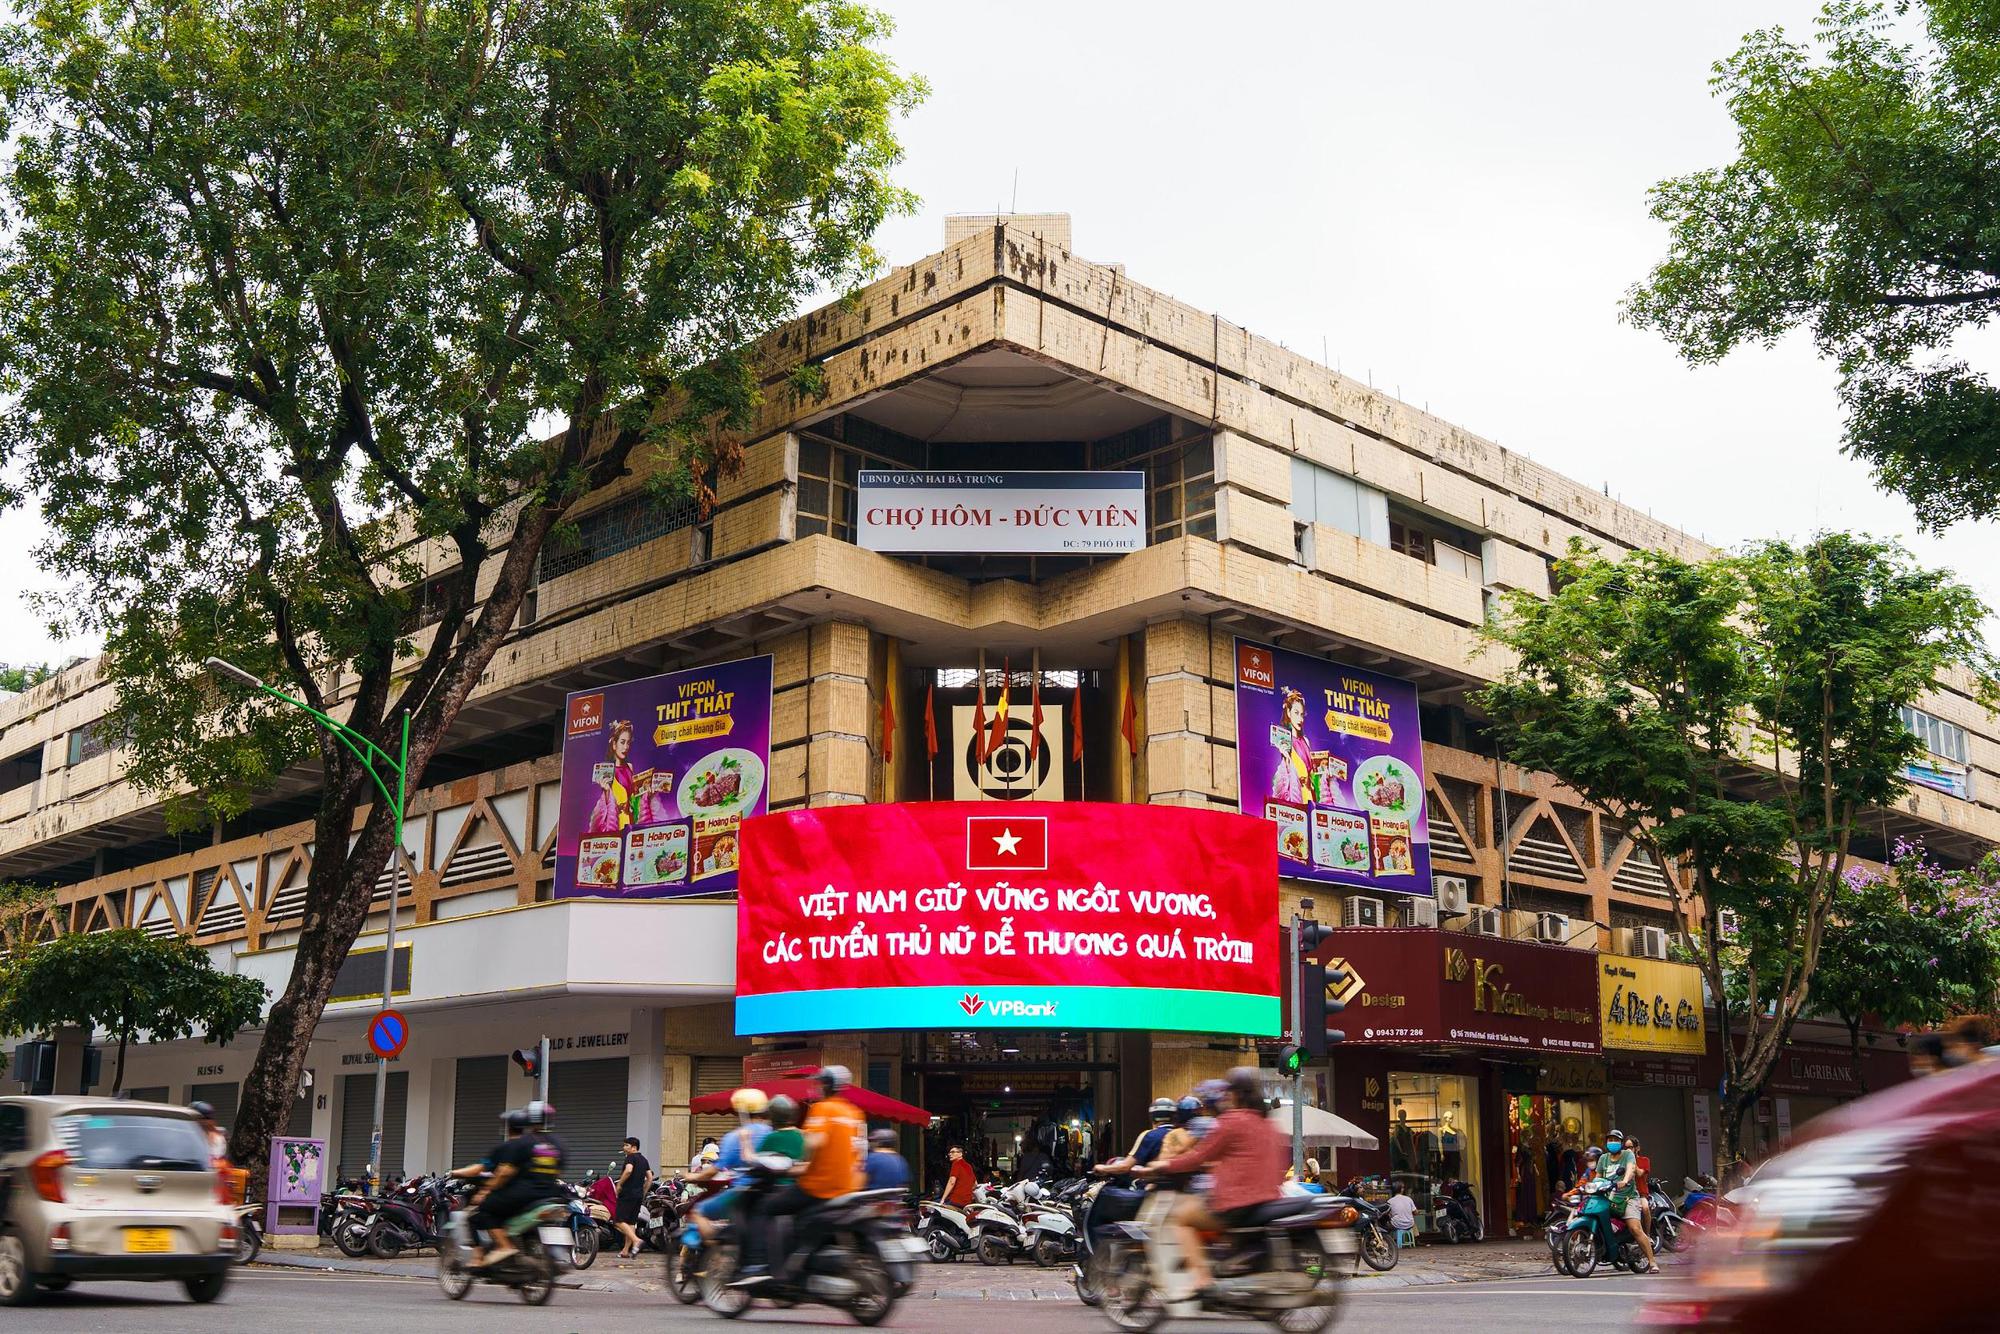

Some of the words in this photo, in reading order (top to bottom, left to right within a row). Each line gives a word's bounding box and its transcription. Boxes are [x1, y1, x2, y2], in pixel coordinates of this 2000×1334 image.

[861, 475, 890, 484] UBND
[892, 474, 923, 485] QUẬN
[926, 475, 945, 484] HAI
[948, 474, 963, 484] BÀ
[965, 474, 1003, 484] TRƯNG
[866, 507, 924, 531] CHỢ
[931, 504, 992, 527] HÔM
[1013, 504, 1069, 527] ĐỨC
[1076, 505, 1138, 527] VIÊN
[1082, 540, 1091, 548] 79
[1243, 667, 1270, 683] VIFON
[678, 679, 715, 698] VIFON
[1342, 677, 1374, 697] VIFON
[656, 700, 691, 722] THỊT
[694, 690, 734, 714] THẬT
[1324, 689, 1355, 712] THỊT
[1357, 698, 1391, 721] THẬT
[573, 715, 599, 728] VIFON
[715, 720, 726, 731] Gia
[708, 817, 728, 828] Hoàng
[730, 815, 740, 824] Gia
[1331, 816, 1353, 829] Hoàng
[1353, 820, 1365, 830] Gia
[647, 830, 673, 842] Hoàng
[673, 829, 686, 838] Gia
[799, 884, 849, 920] VIỆT
[856, 890, 907, 913] NAM
[915, 882, 967, 912] GIỮ
[975, 881, 1049, 912] VỮNG
[1057, 881, 1120, 912] NGÔI
[1128, 890, 1216, 920] VƯƠNG,
[763, 932, 803, 964] CÁC
[808, 921, 878, 960] TUYỂN
[885, 924, 932, 956] THỦ
[939, 925, 976, 955] NỮ
[984, 916, 1016, 956] DỄ
[1024, 931, 1128, 956] THƯƠNG
[1136, 928, 1186, 959] QUÁ
[988, 1000, 1056, 1016] VPBank
[1361, 992, 1406, 1009] Design
[567, 1037, 573, 1048] &
[576, 1033, 628, 1048] JEWELLERY
[1376, 1029, 1394, 1037] 0943
[1395, 1029, 1409, 1037] 787
[1410, 1029, 1424, 1037] 286
[197, 1065, 224, 1075] RISIS
[1803, 1065, 1852, 1081] AGRIBANK
[317, 1095, 326, 1109] 81
[1361, 1099, 1384, 1112] Design
